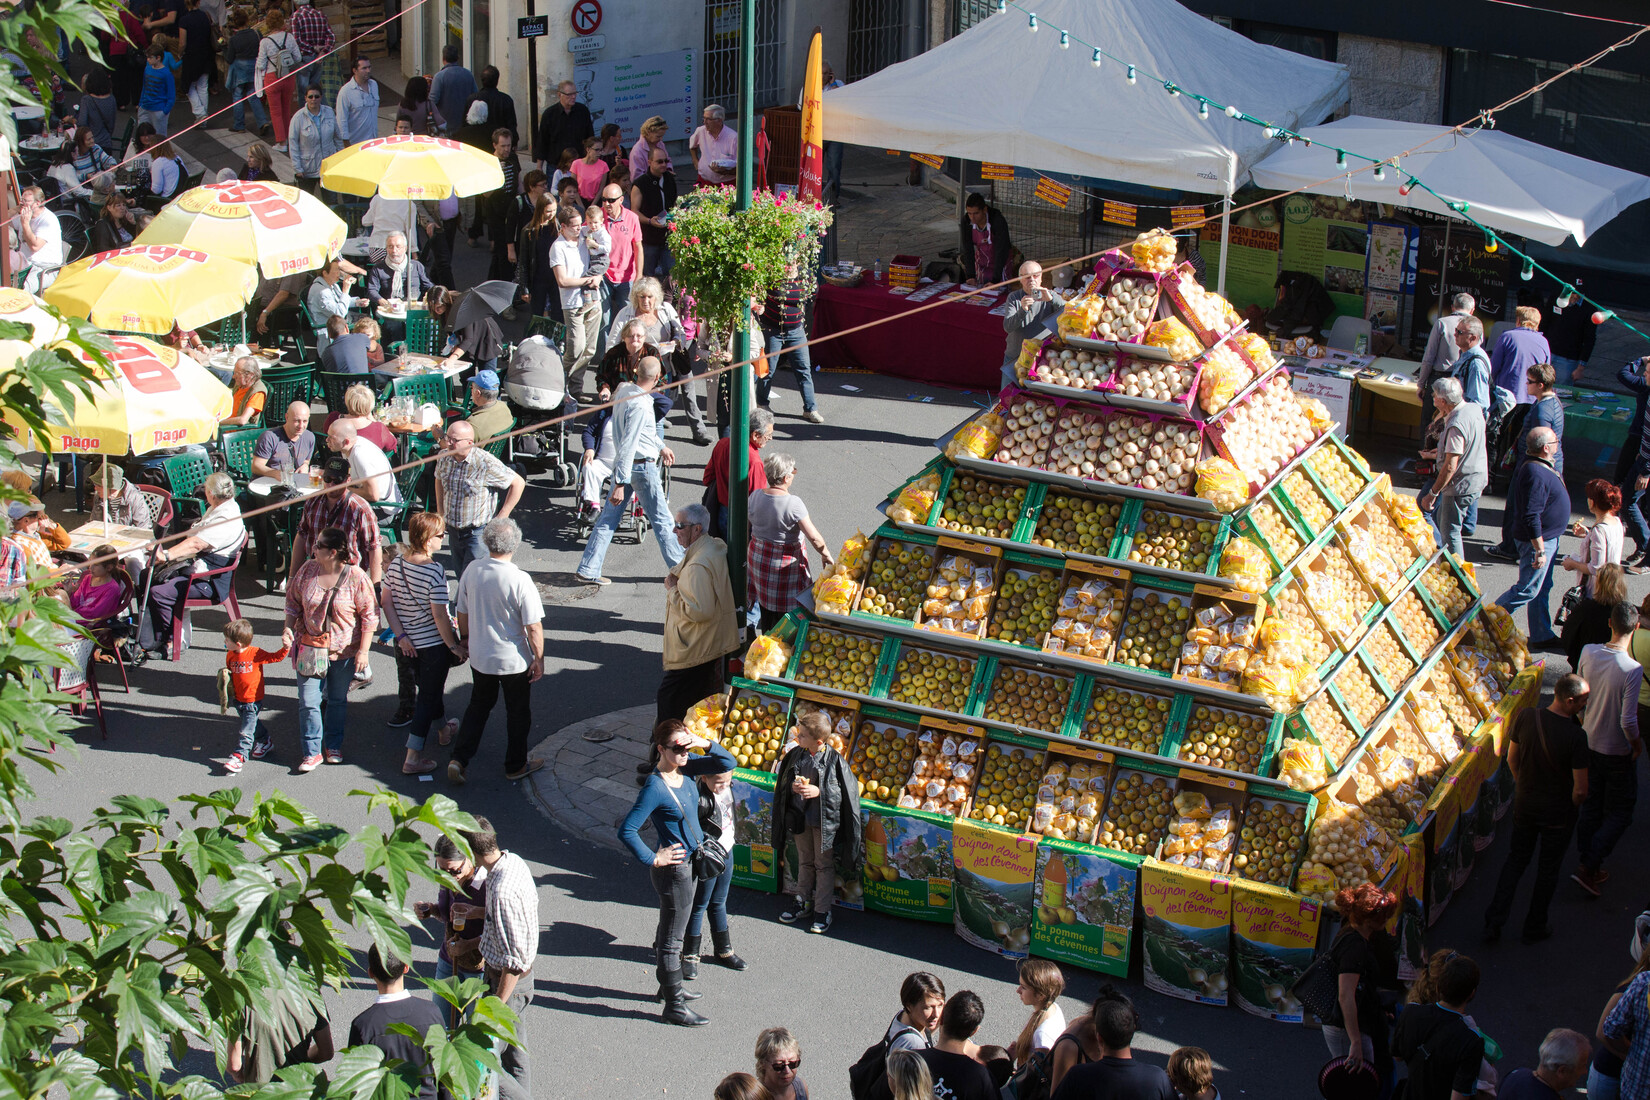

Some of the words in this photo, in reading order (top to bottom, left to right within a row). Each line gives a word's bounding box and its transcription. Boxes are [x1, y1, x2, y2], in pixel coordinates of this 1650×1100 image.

[574, 43, 600, 51] RIVERAINS
[632, 82, 651, 90] Cévenol
[208, 204, 240, 216] RUIT
[1286, 205, 1310, 215] A.O.P.
[1414, 210, 1423, 218] de
[1203, 222, 1248, 237] L'OINON
[1251, 229, 1279, 241] DOUX
[1231, 236, 1279, 252] CÉVENNES
[89, 246, 208, 270] pago
[281, 256, 309, 274] pago
[1087, 278, 1100, 295] DOUX
[122, 315, 141, 325] pago
[1176, 292, 1193, 315] OIGNON
[1190, 314, 1206, 331] DOUX
[61, 434, 100, 451] pago
[153, 428, 187, 446] pago
[1219, 441, 1235, 464] OIGNON
[953, 835, 994, 857] l'Oignon
[996, 845, 1021, 863] doux
[973, 856, 989, 868] des
[990, 855, 1033, 877] Cévennes
[863, 877, 873, 887] La
[876, 883, 909, 897] pomme
[1144, 882, 1186, 904] l'Oignon
[1188, 889, 1215, 906] doux
[863, 888, 878, 898] des
[881, 892, 925, 907] Cévennes
[1165, 902, 1182, 915] des
[1183, 900, 1228, 920] Cévennes
[1275, 911, 1303, 928] doux
[1036, 921, 1046, 932] La
[1049, 927, 1084, 941] pomme
[1249, 922, 1267, 934] des
[1268, 920, 1314, 943] Cévennes
[1035, 932, 1051, 943] des
[1054, 936, 1098, 955] Cévennes
